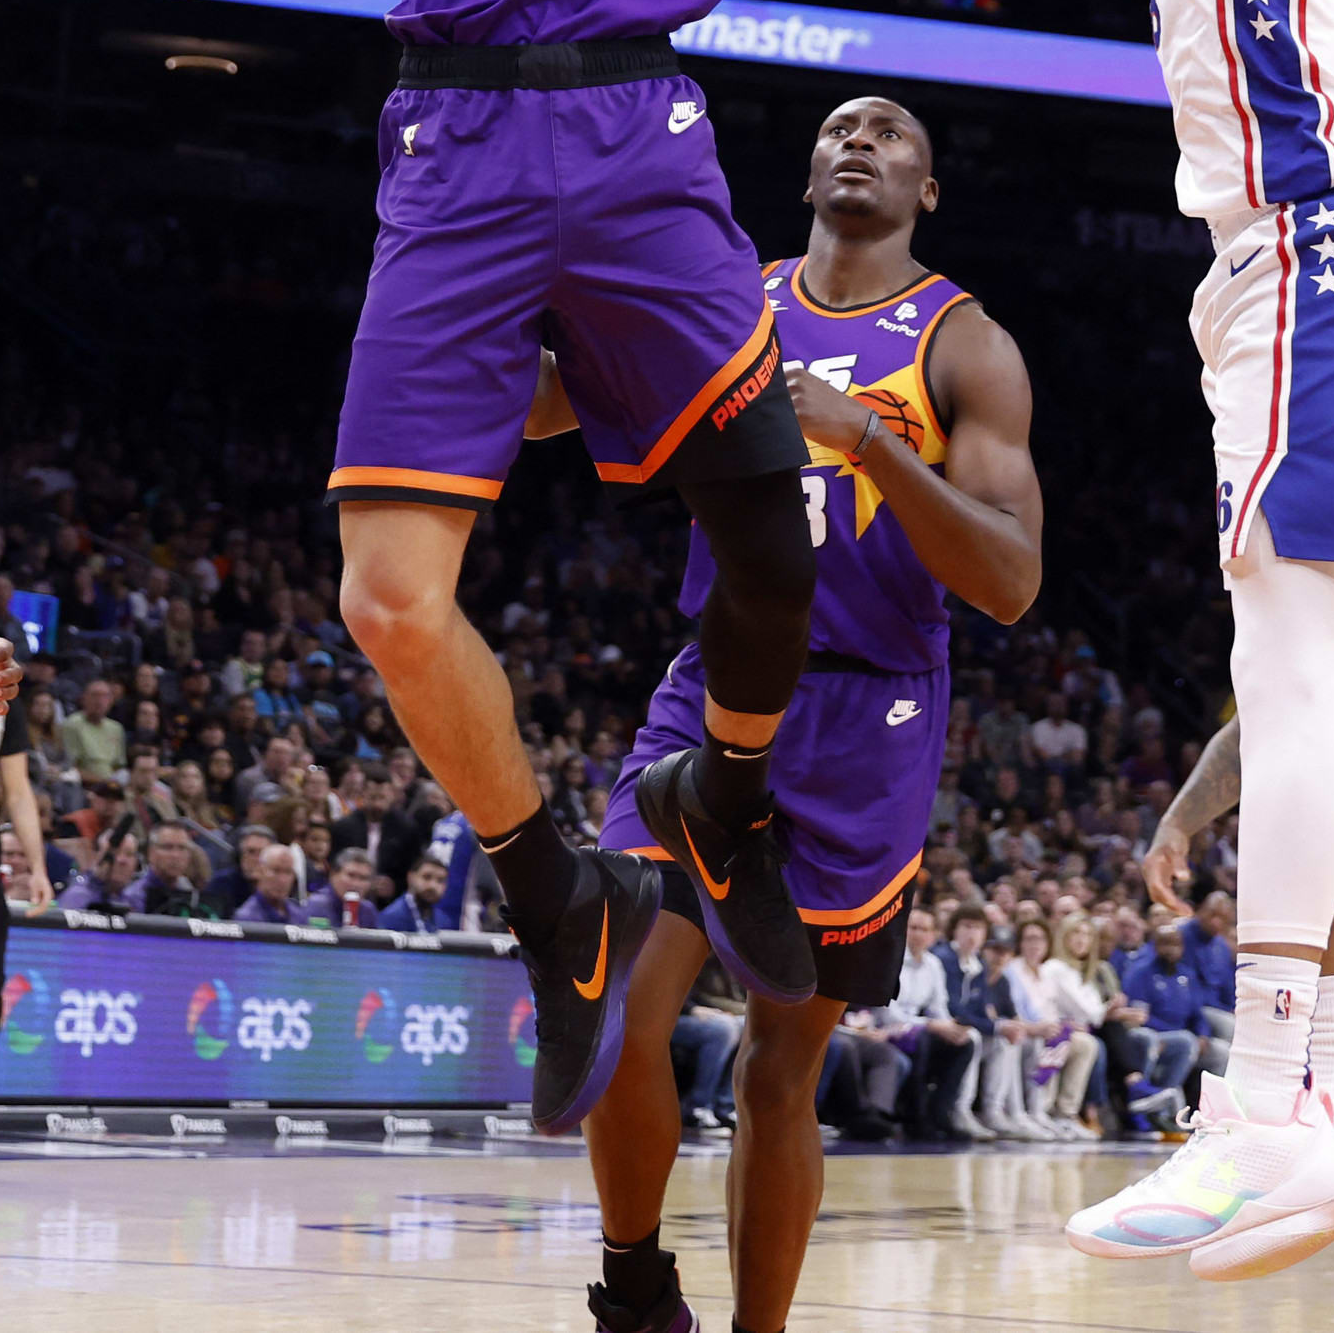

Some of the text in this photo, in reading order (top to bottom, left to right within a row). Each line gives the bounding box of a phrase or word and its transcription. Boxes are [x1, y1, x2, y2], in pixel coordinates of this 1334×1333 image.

[764, 277, 783, 290] 6
[875, 318, 921, 338] PayPal
[821, 893, 904, 946] PHOENIX
[55, 989, 138, 1057] aps
[238, 998, 313, 1061] aps
[401, 1004, 469, 1065] aps
